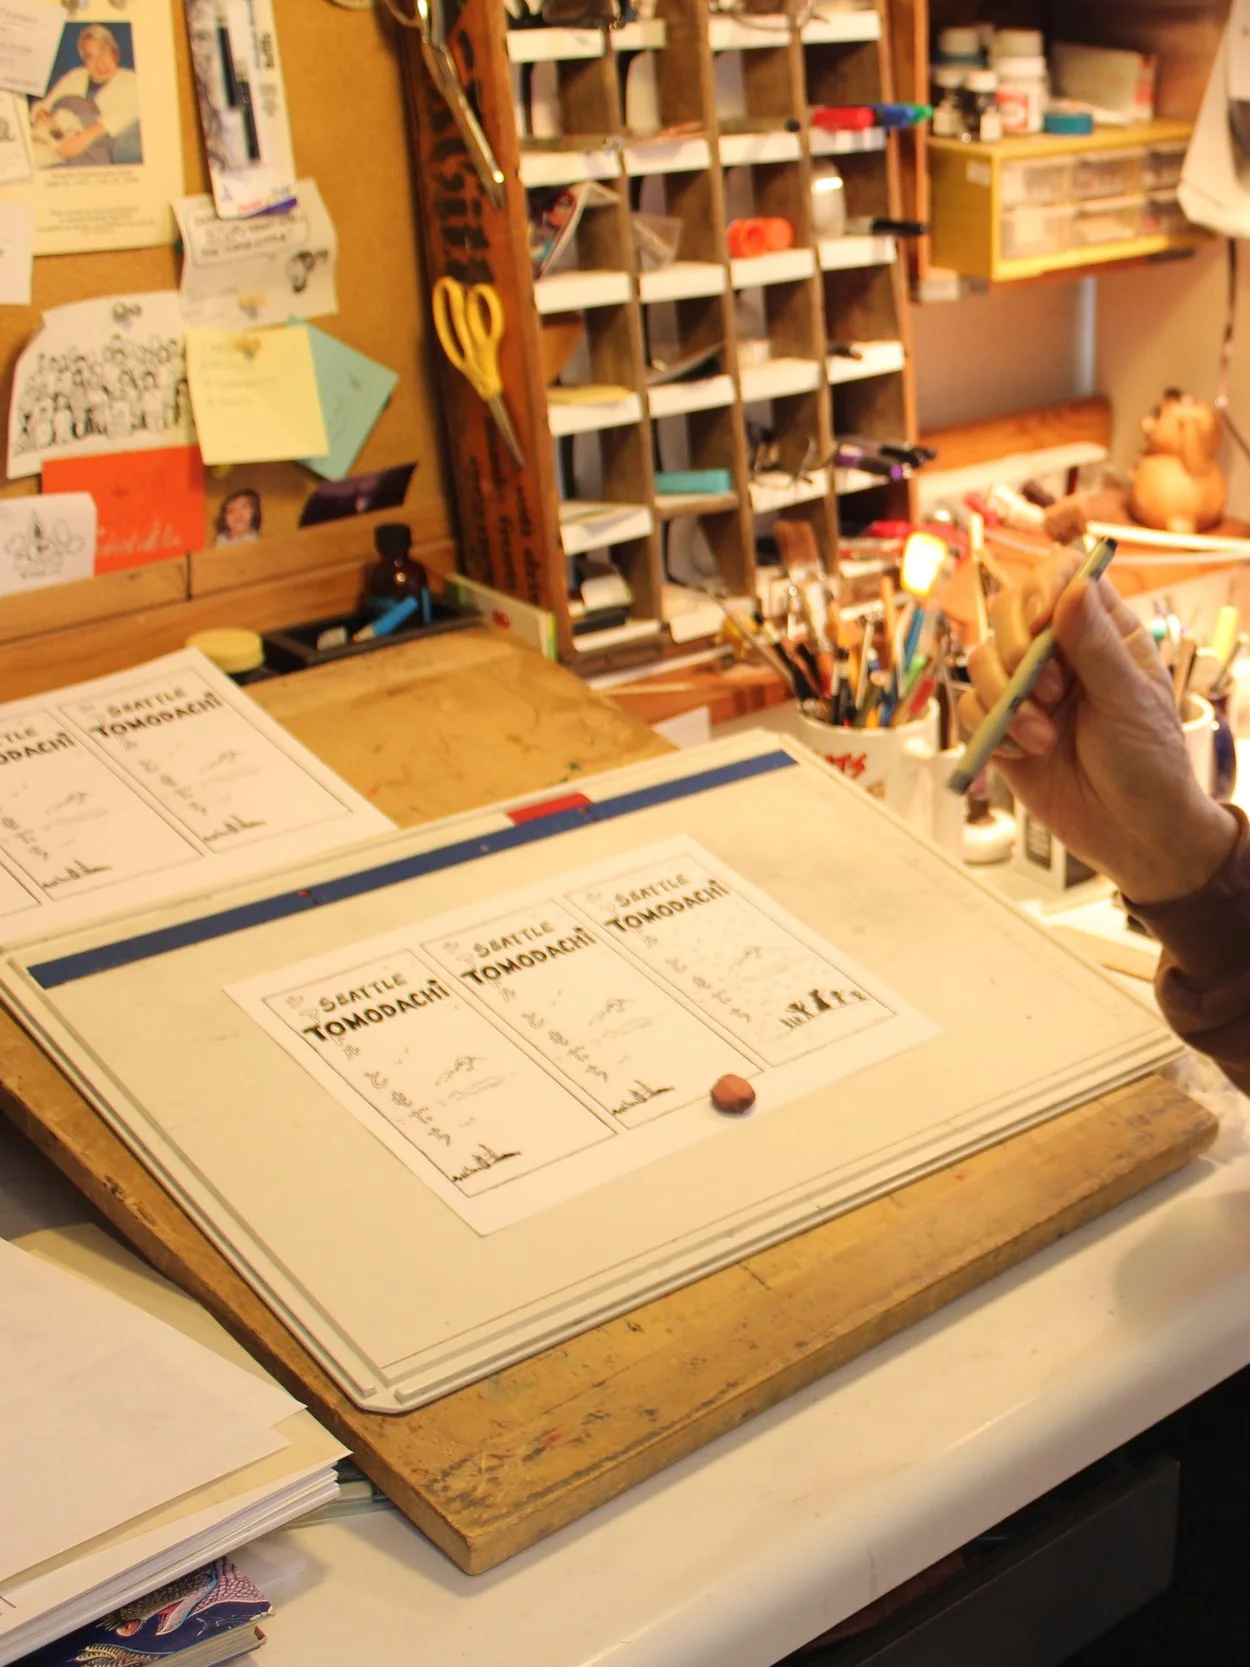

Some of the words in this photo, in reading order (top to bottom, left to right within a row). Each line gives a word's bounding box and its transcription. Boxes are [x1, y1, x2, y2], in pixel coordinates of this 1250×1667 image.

[108, 689, 186, 717] SEATTLE
[614, 873, 692, 908] SEATTLE
[473, 920, 556, 959] SEATTLE
[318, 972, 408, 1013] SEATTLE
